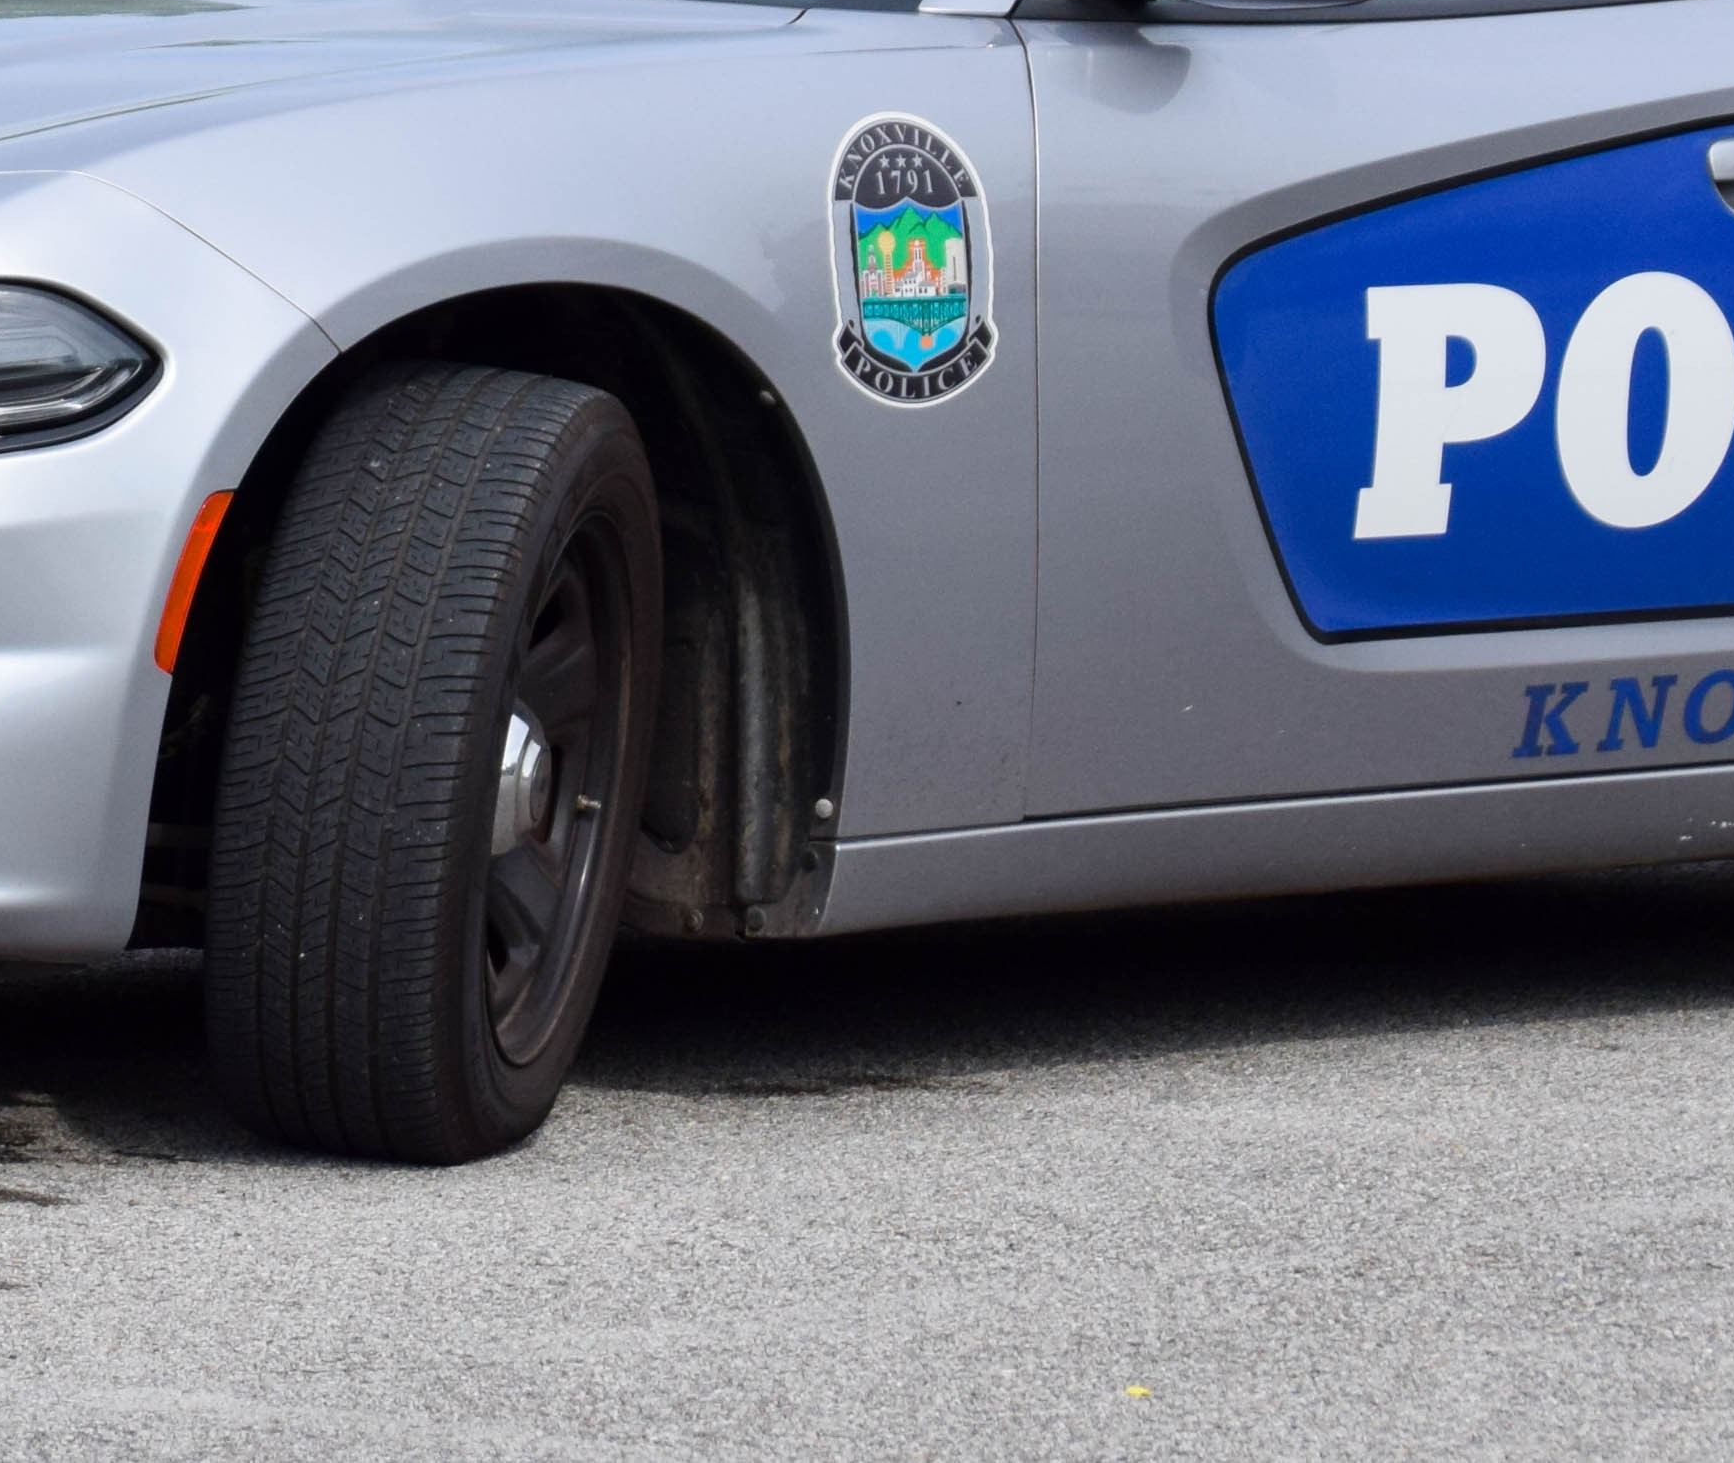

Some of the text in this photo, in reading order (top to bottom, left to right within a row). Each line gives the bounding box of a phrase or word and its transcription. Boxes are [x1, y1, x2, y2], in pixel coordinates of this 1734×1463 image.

[837, 124, 972, 191] KNOXVILLE
[876, 169, 934, 195] 1791
[854, 350, 980, 398] POLICE
